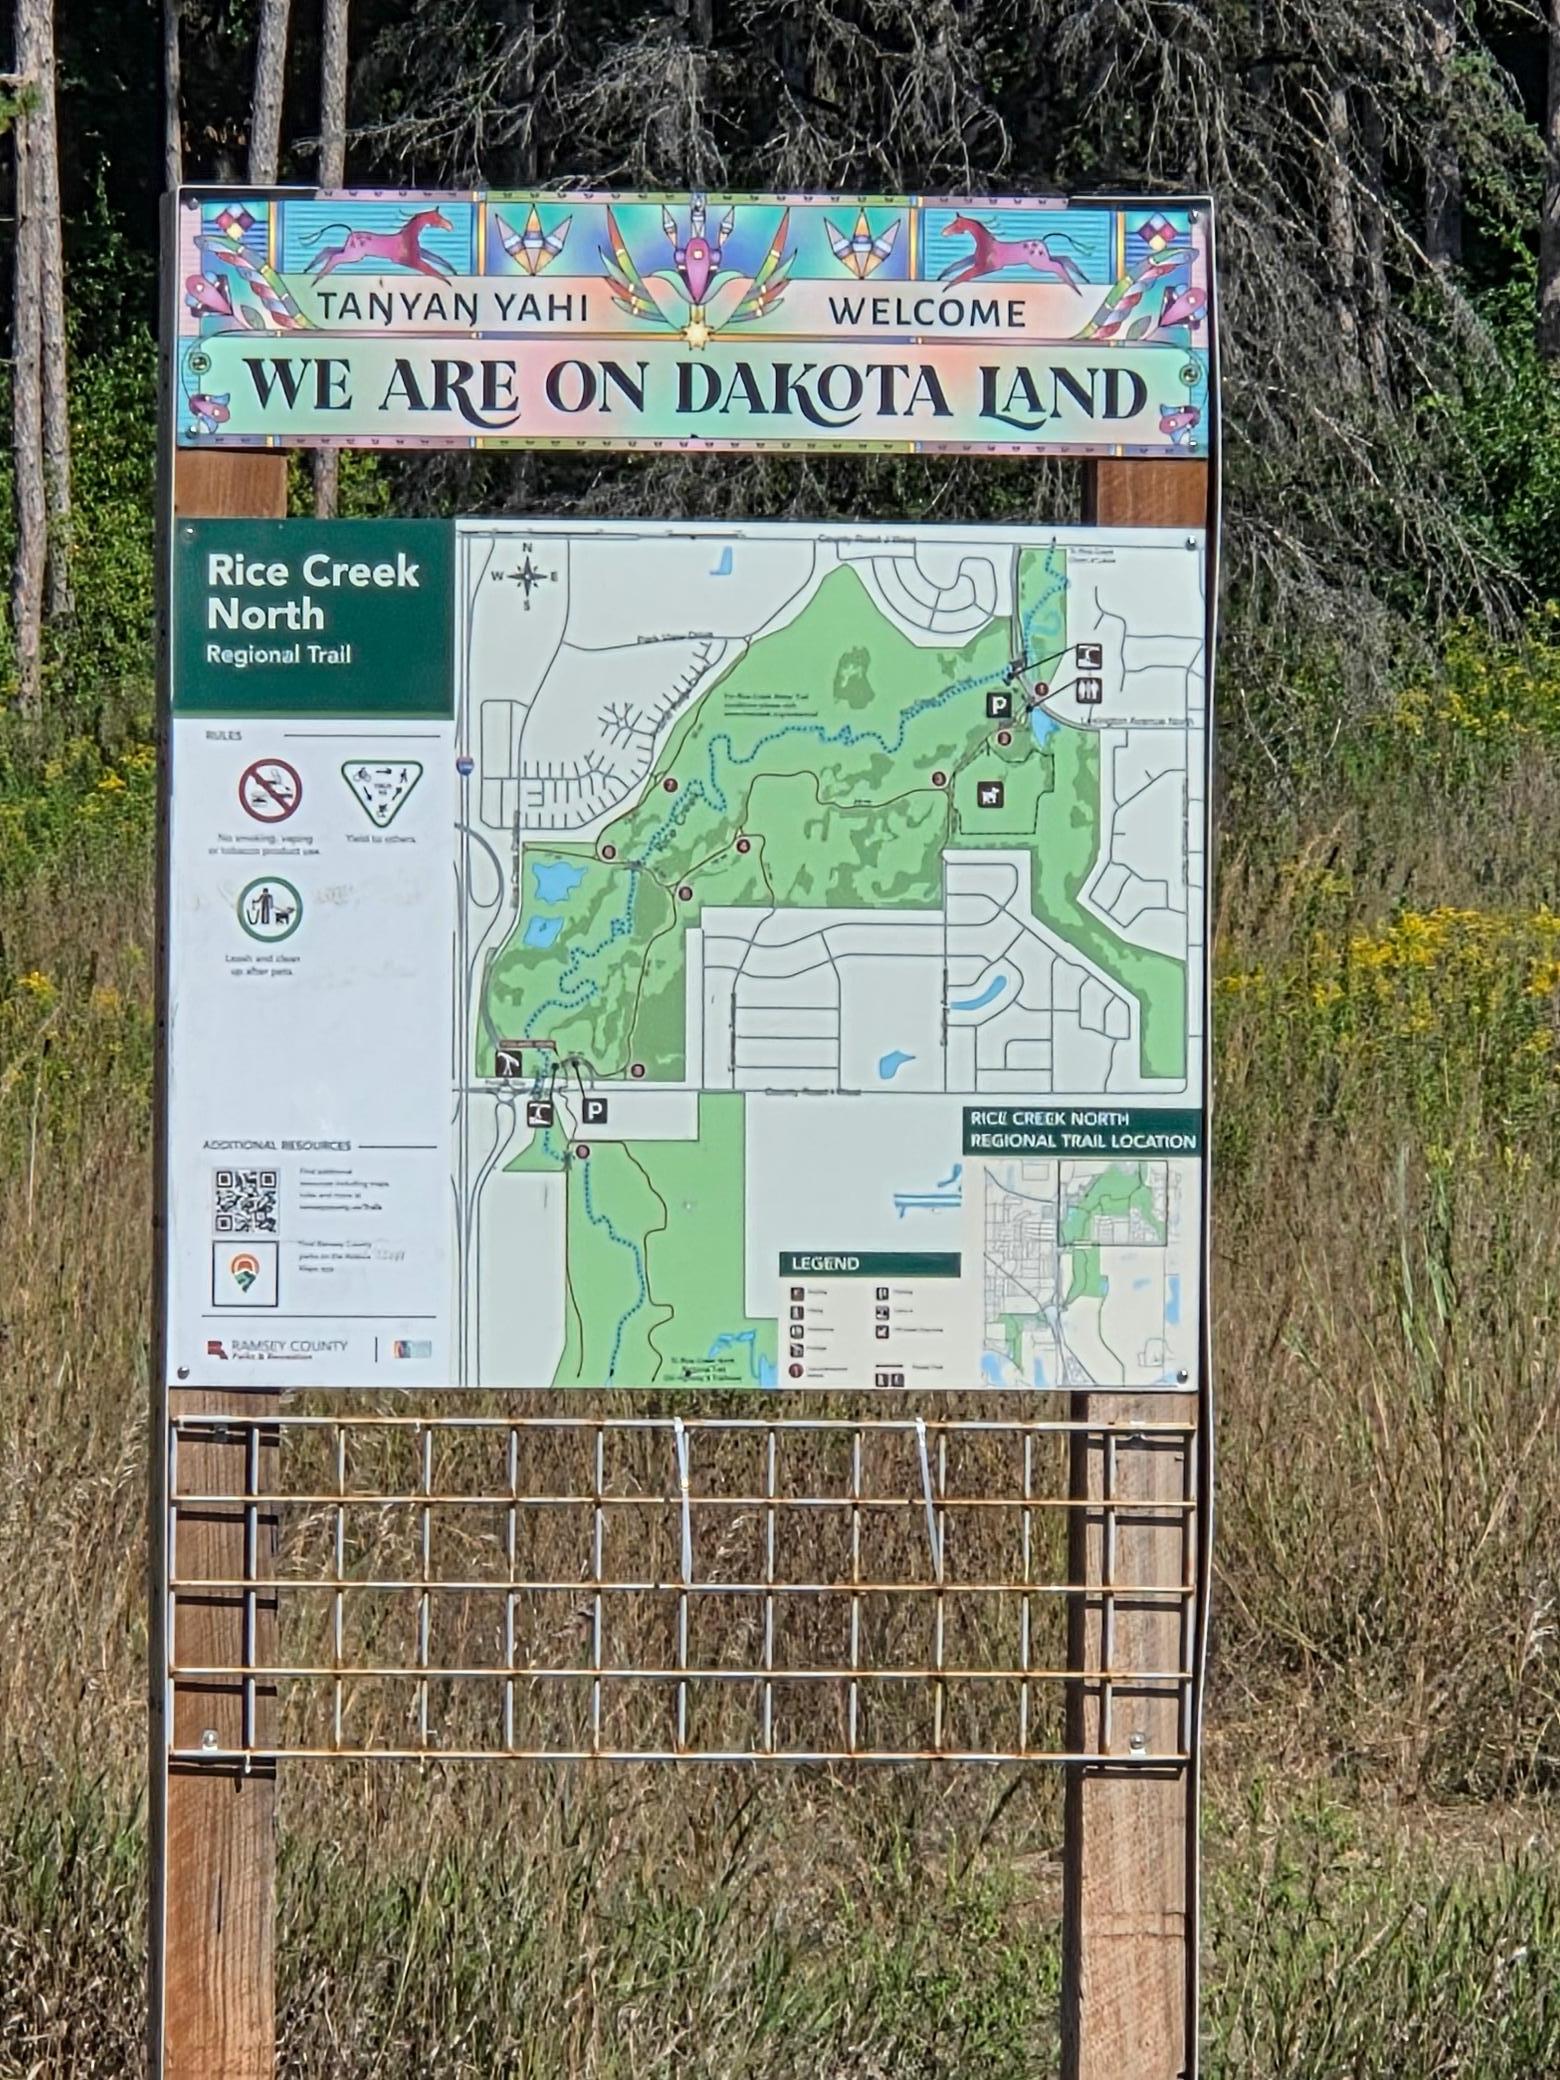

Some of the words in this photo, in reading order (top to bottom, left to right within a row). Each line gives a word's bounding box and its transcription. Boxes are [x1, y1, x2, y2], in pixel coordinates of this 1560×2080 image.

[494, 292, 588, 322] YAHI
[828, 296, 1027, 328] WELCOME
[242, 358, 353, 410] WE
[378, 358, 522, 429] ARE
[545, 360, 650, 413] ON
[675, 361, 954, 429] DAKOTA
[978, 365, 1149, 431] LAND
[522, 542, 532, 552] N
[208, 553, 290, 587] Rice
[302, 552, 421, 588] Creek
[490, 571, 504, 581] W
[207, 595, 325, 631] North
[206, 643, 300, 668] Regional
[306, 643, 352, 664] Trail
[992, 695, 1008, 716] P
[205, 730, 242, 741] RULES
[587, 1101, 604, 1121] P
[970, 1110, 1007, 1126] RICE
[1012, 1111, 1067, 1127] CREEK
[1070, 1111, 1130, 1127] NORTH
[203, 1139, 277, 1151] ADDITIONAL
[281, 1139, 352, 1152] RESOURCES
[970, 1132, 1057, 1149] REGIONAL
[1062, 1133, 1107, 1149] TRAIL
[1111, 1134, 1198, 1150] LOCATION
[791, 1255, 861, 1272] LEGEND
[231, 1339, 285, 1352] RAMSEY
[290, 1340, 349, 1353] COUNTY
